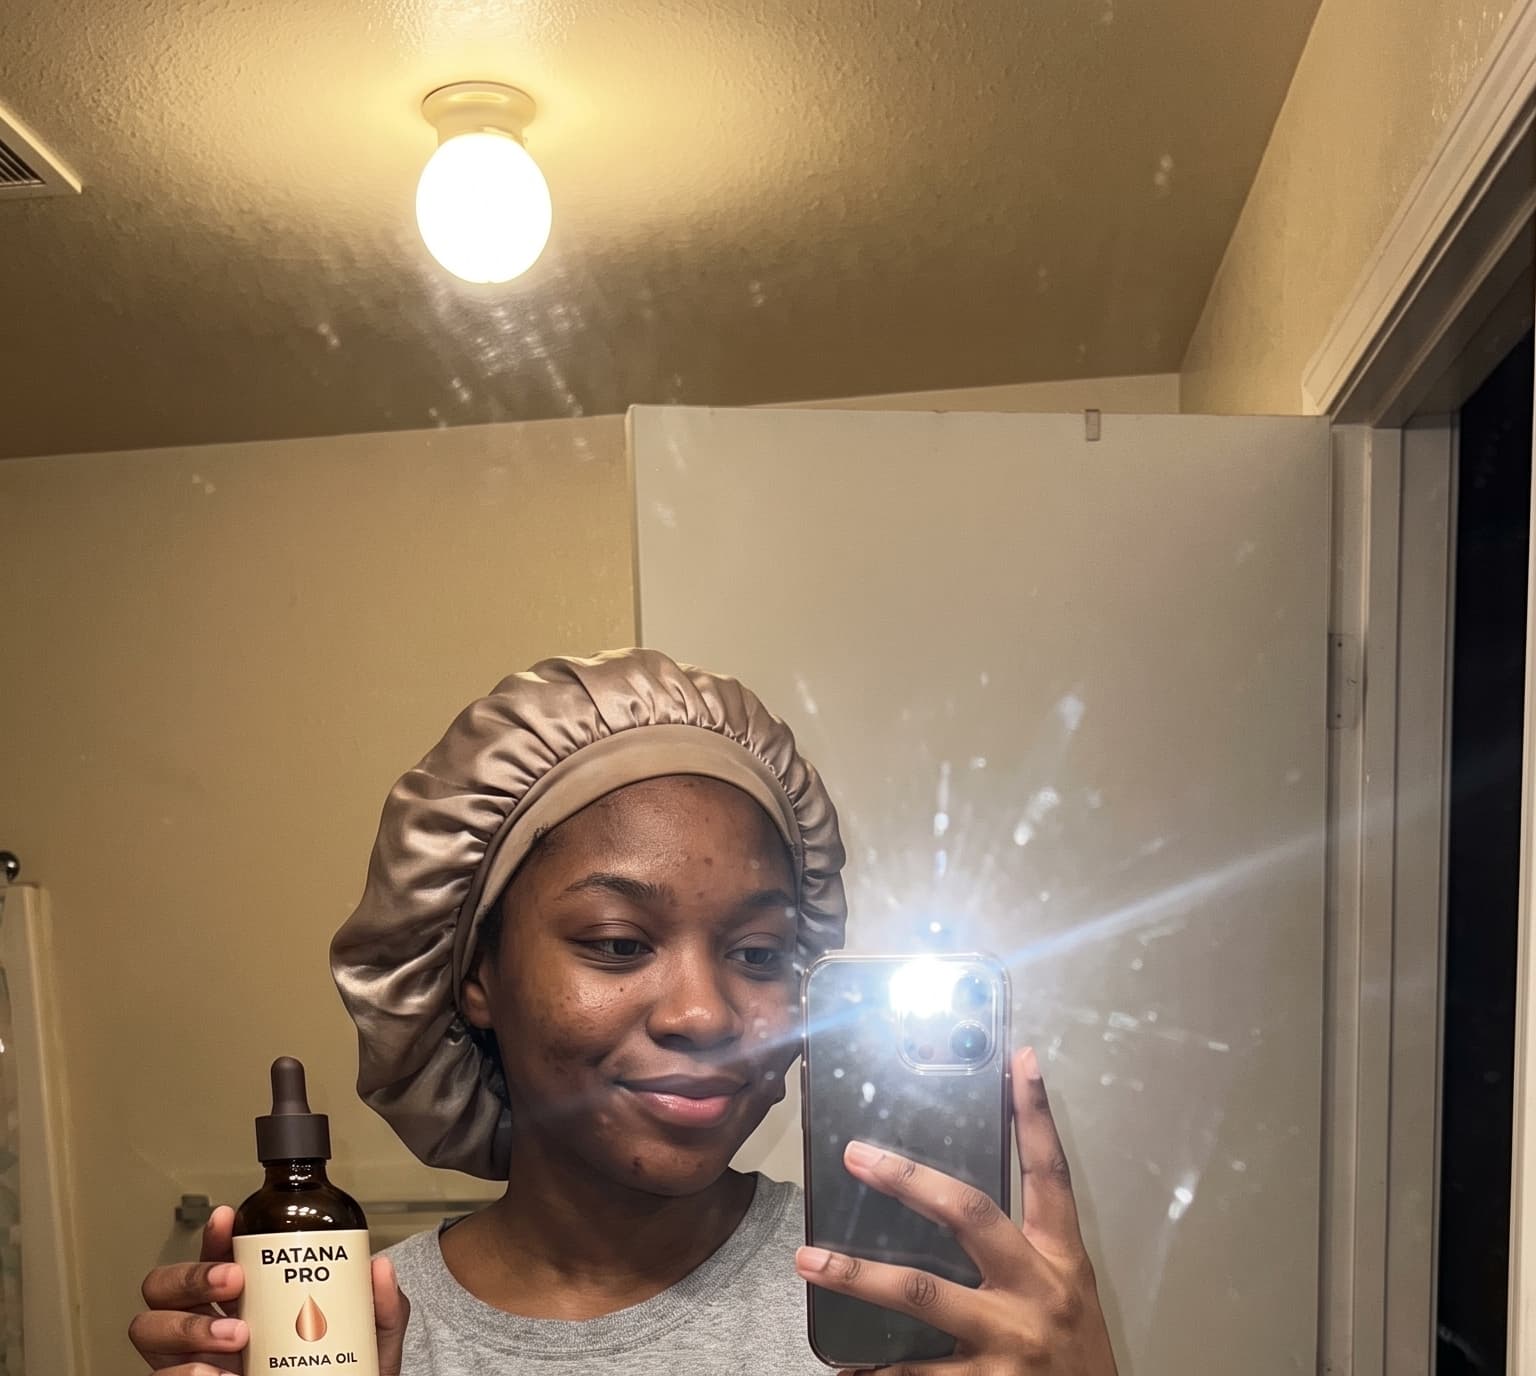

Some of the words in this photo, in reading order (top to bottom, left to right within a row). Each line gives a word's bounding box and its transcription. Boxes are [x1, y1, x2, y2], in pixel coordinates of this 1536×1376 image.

[261, 1245, 348, 1265] BATANA
[284, 1266, 330, 1283] PRO
[269, 1354, 332, 1369] BATANA
[336, 1351, 358, 1364] OIL
